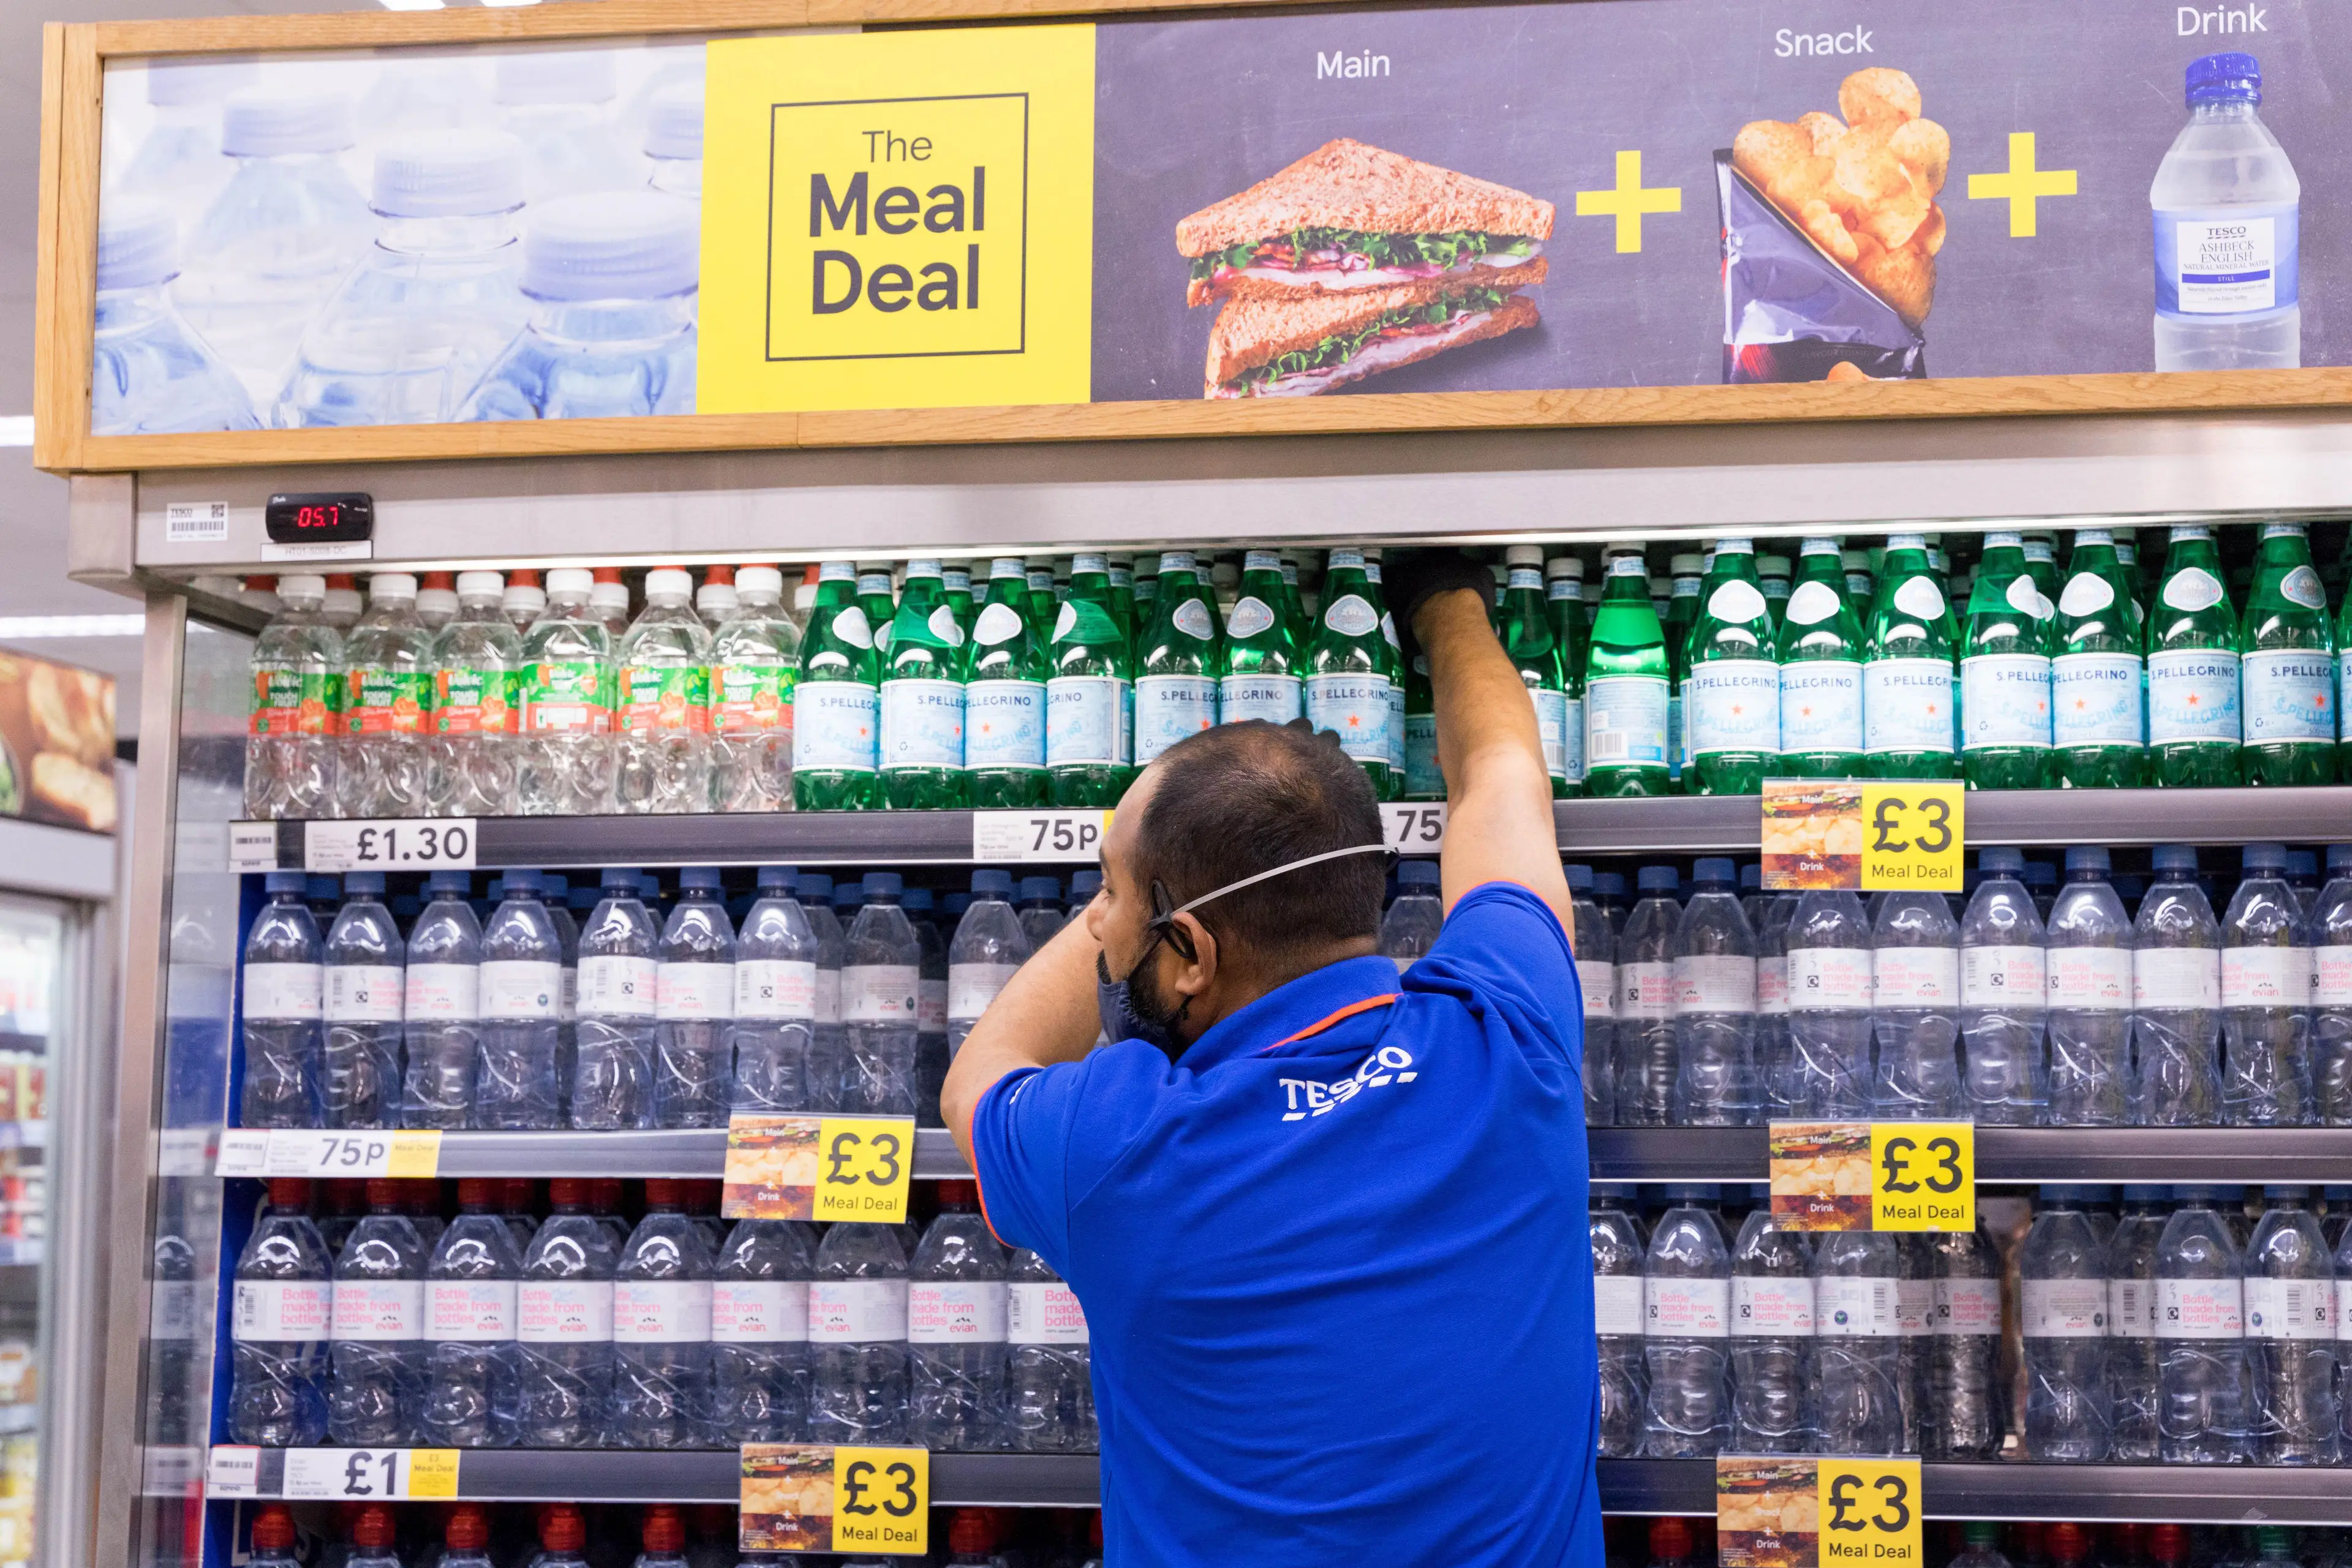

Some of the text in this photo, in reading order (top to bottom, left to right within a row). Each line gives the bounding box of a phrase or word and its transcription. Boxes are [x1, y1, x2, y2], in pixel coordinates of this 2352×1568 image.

[2177, 2, 2267, 36] Drink
[1774, 25, 1874, 57] Snack
[1317, 49, 1390, 80] Main
[862, 130, 933, 163] The
[809, 165, 986, 238] Meal
[2207, 226, 2247, 236] TESCO
[2199, 240, 2255, 253] ASHBECK
[2201, 252, 2253, 263] ENGLISH
[2249, 259, 2269, 268] WATER
[812, 244, 979, 315] Deal
[1396, 810, 1442, 842] 75
[1872, 797, 1953, 853] £3
[1030, 819, 1098, 851] 75p
[357, 826, 468, 861] £1.30
[1800, 862, 1824, 871] Drink
[1872, 864, 1953, 878] Meal Deal
[1917, 989, 1941, 997] evian
[2252, 988, 2278, 997] evian
[1279, 1046, 1412, 1110] TESCO
[320, 1137, 385, 1166] 75p
[826, 1132, 900, 1186] £3
[1882, 1137, 1963, 1194] £3
[758, 1193, 780, 1202] Drink
[823, 1196, 898, 1211] Meal Deal
[1810, 1204, 1834, 1213] Drink
[1882, 1205, 1964, 1219] Meal Deal
[282, 1288, 319, 1300] Bottle
[435, 1288, 470, 1300] Bottle
[1044, 1289, 1077, 1302] Bott
[1660, 1293, 1689, 1302] Bottle
[1754, 1292, 1785, 1302] Bottle
[1953, 1293, 1983, 1302] Bottle
[2182, 1294, 2214, 1304] Bottle
[282, 1302, 317, 1311] made
[369, 1300, 401, 1311] from
[435, 1300, 502, 1311] made from
[554, 1302, 585, 1313] from
[632, 1302, 660, 1313] from
[733, 1302, 763, 1313] from
[821, 1302, 847, 1313] from
[943, 1302, 974, 1313] from
[1045, 1303, 1083, 1314] made
[1660, 1303, 1714, 1312] made from
[1786, 1303, 1807, 1311] from
[281, 1313, 322, 1324] bottles
[435, 1313, 475, 1324] bottles
[1660, 1313, 1694, 1321] bottles
[1754, 1312, 1790, 1321] bottles
[2182, 1314, 2220, 1322] bottles
[375, 1322, 402, 1331] evian
[477, 1321, 503, 1332] evian
[560, 1322, 587, 1332] evian
[637, 1322, 663, 1332] evian
[739, 1322, 766, 1332] evian
[825, 1322, 850, 1332] evian
[949, 1323, 978, 1333] evian
[343, 1451, 398, 1496] £1
[843, 1461, 917, 1517] £3
[1828, 1474, 1910, 1532] £3
[775, 1523, 798, 1532] Drink
[842, 1526, 917, 1542] Meal Deal
[1756, 1539, 1781, 1549] Drink
[1828, 1543, 1911, 1559] Meal Deal
